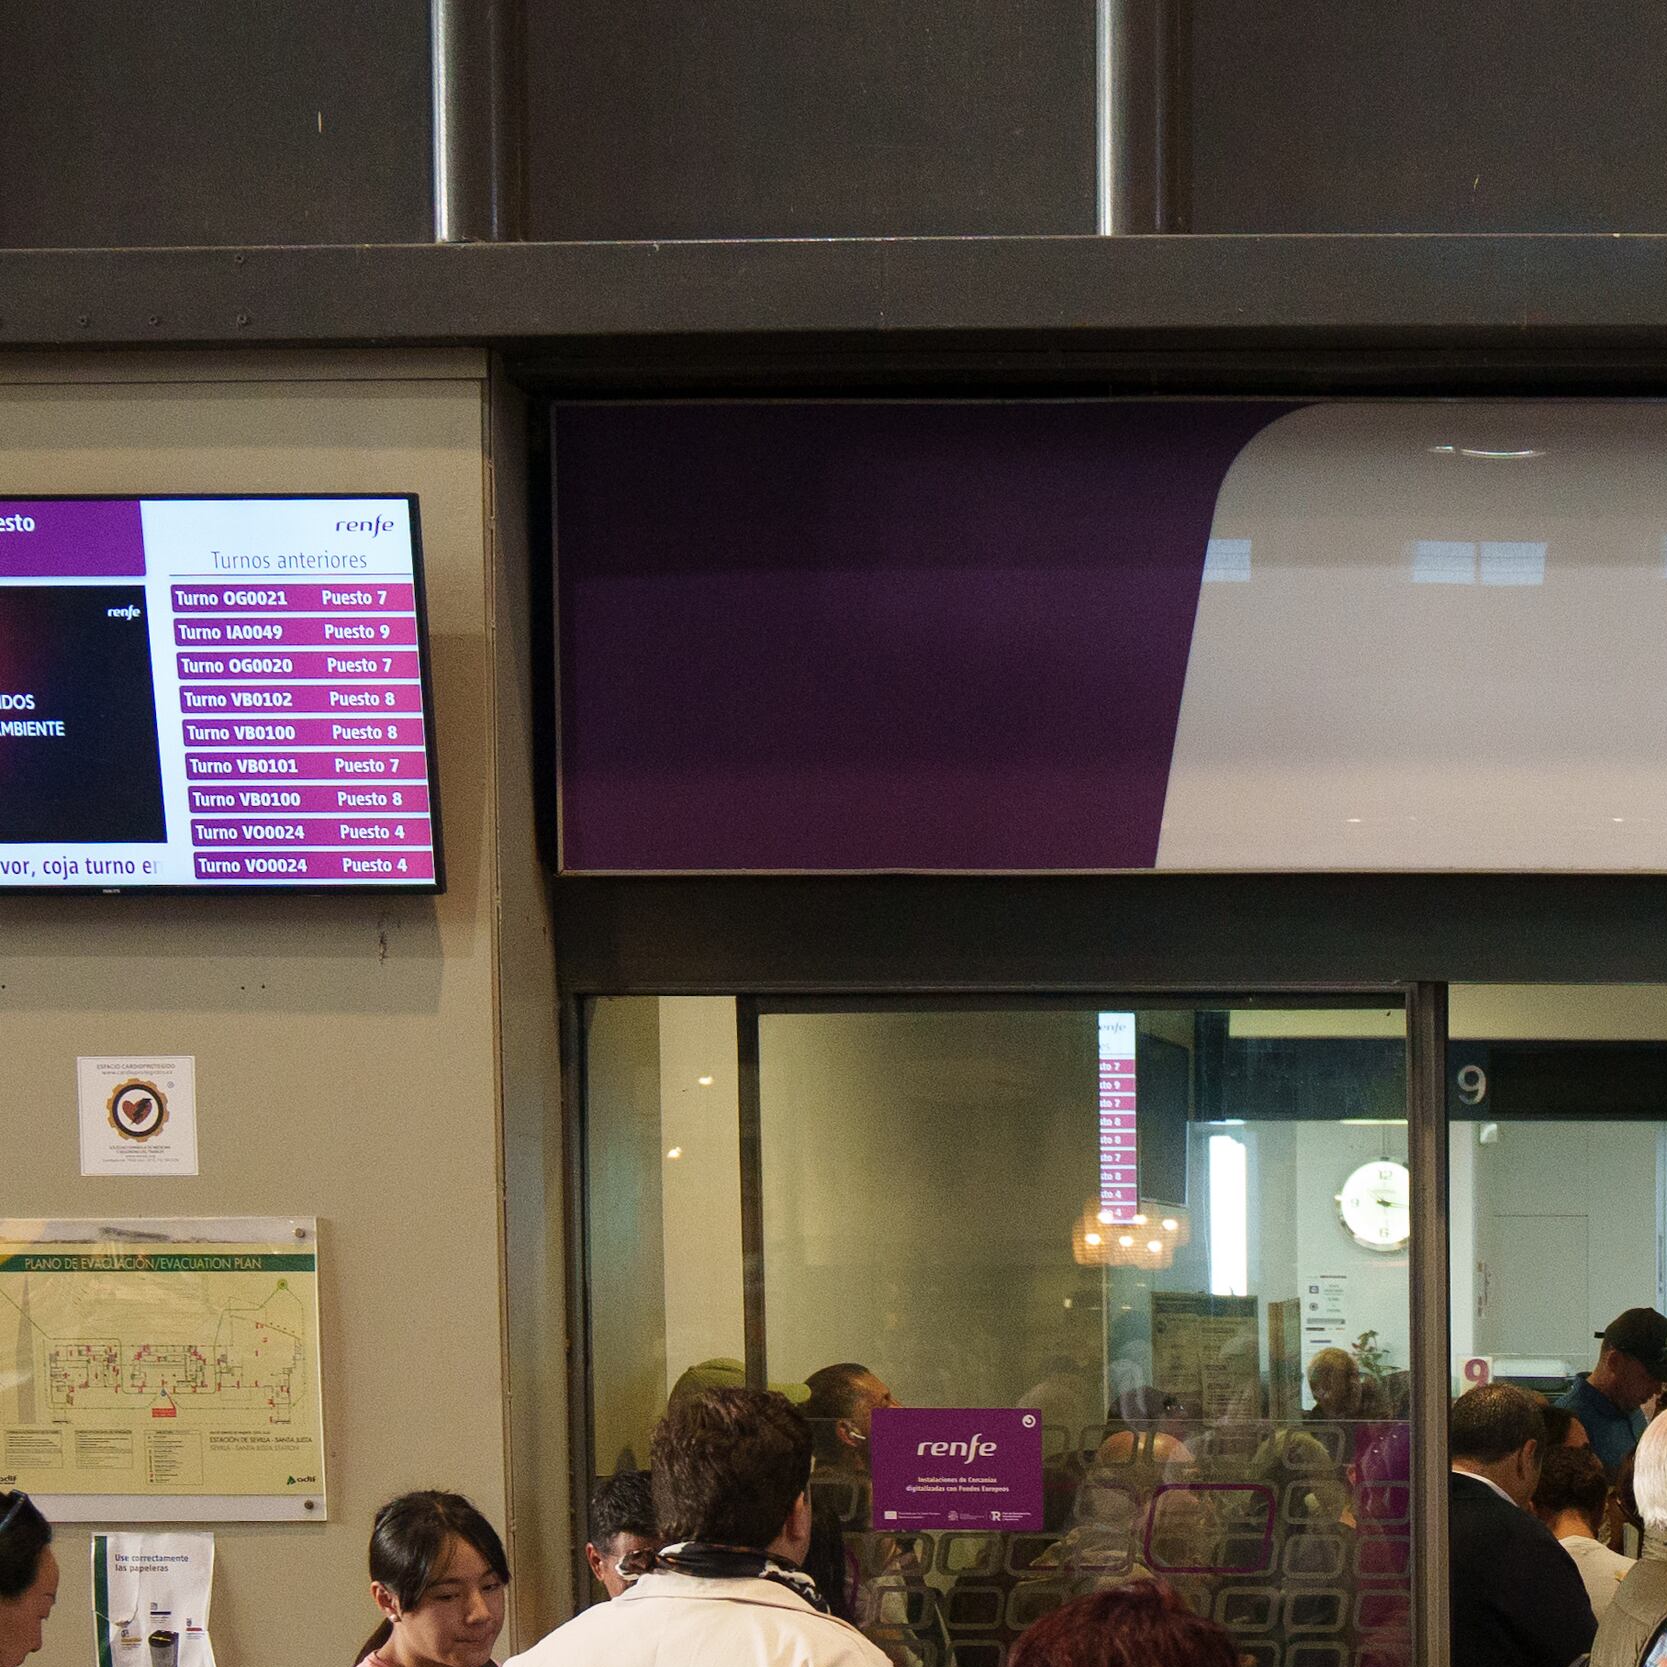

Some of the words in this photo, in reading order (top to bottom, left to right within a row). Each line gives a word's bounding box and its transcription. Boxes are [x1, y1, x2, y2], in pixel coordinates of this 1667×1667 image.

[336, 514, 394, 538] renfe
[212, 551, 269, 569] Turnos
[278, 551, 367, 569] anteriores
[175, 590, 218, 606] Turno
[322, 590, 372, 606] Puesto
[377, 590, 387, 606] 7
[108, 604, 140, 620] renfe
[179, 625, 220, 640] Turno
[226, 625, 282, 640] IA0049
[324, 625, 374, 640] Puesto
[380, 625, 390, 640] 9
[181, 658, 223, 673] Turno
[327, 658, 377, 673] Puesto
[382, 658, 392, 673] 7
[184, 692, 226, 707] Turno
[330, 692, 379, 707] Puesto
[385, 692, 395, 707] 8
[187, 726, 229, 741] Turno
[332, 726, 382, 741] Puesto
[388, 726, 397, 741] 8
[190, 759, 232, 774] Turno
[335, 759, 384, 774] Puesto
[390, 759, 400, 774] 7
[193, 792, 234, 807] Turno
[338, 792, 387, 807] Puesto
[393, 792, 402, 807] 8
[196, 825, 237, 840] Turno
[340, 825, 390, 840] Puesto
[395, 825, 405, 840] 4
[43, 856, 78, 880] coja
[85, 857, 135, 874] turno
[199, 858, 240, 873] Turno
[343, 858, 392, 873] Puesto
[397, 858, 407, 873] 4
[1457, 1065, 1487, 1105] 9
[25, 1258, 61, 1269] PLANO
[65, 1258, 78, 1269] DE
[235, 1258, 262, 1269] PLAN
[917, 1433, 997, 1464] renfe
[115, 1554, 129, 1562] Use
[132, 1554, 189, 1562] correctamente
[115, 1564, 127, 1572] las
[130, 1564, 169, 1573] papeleras
